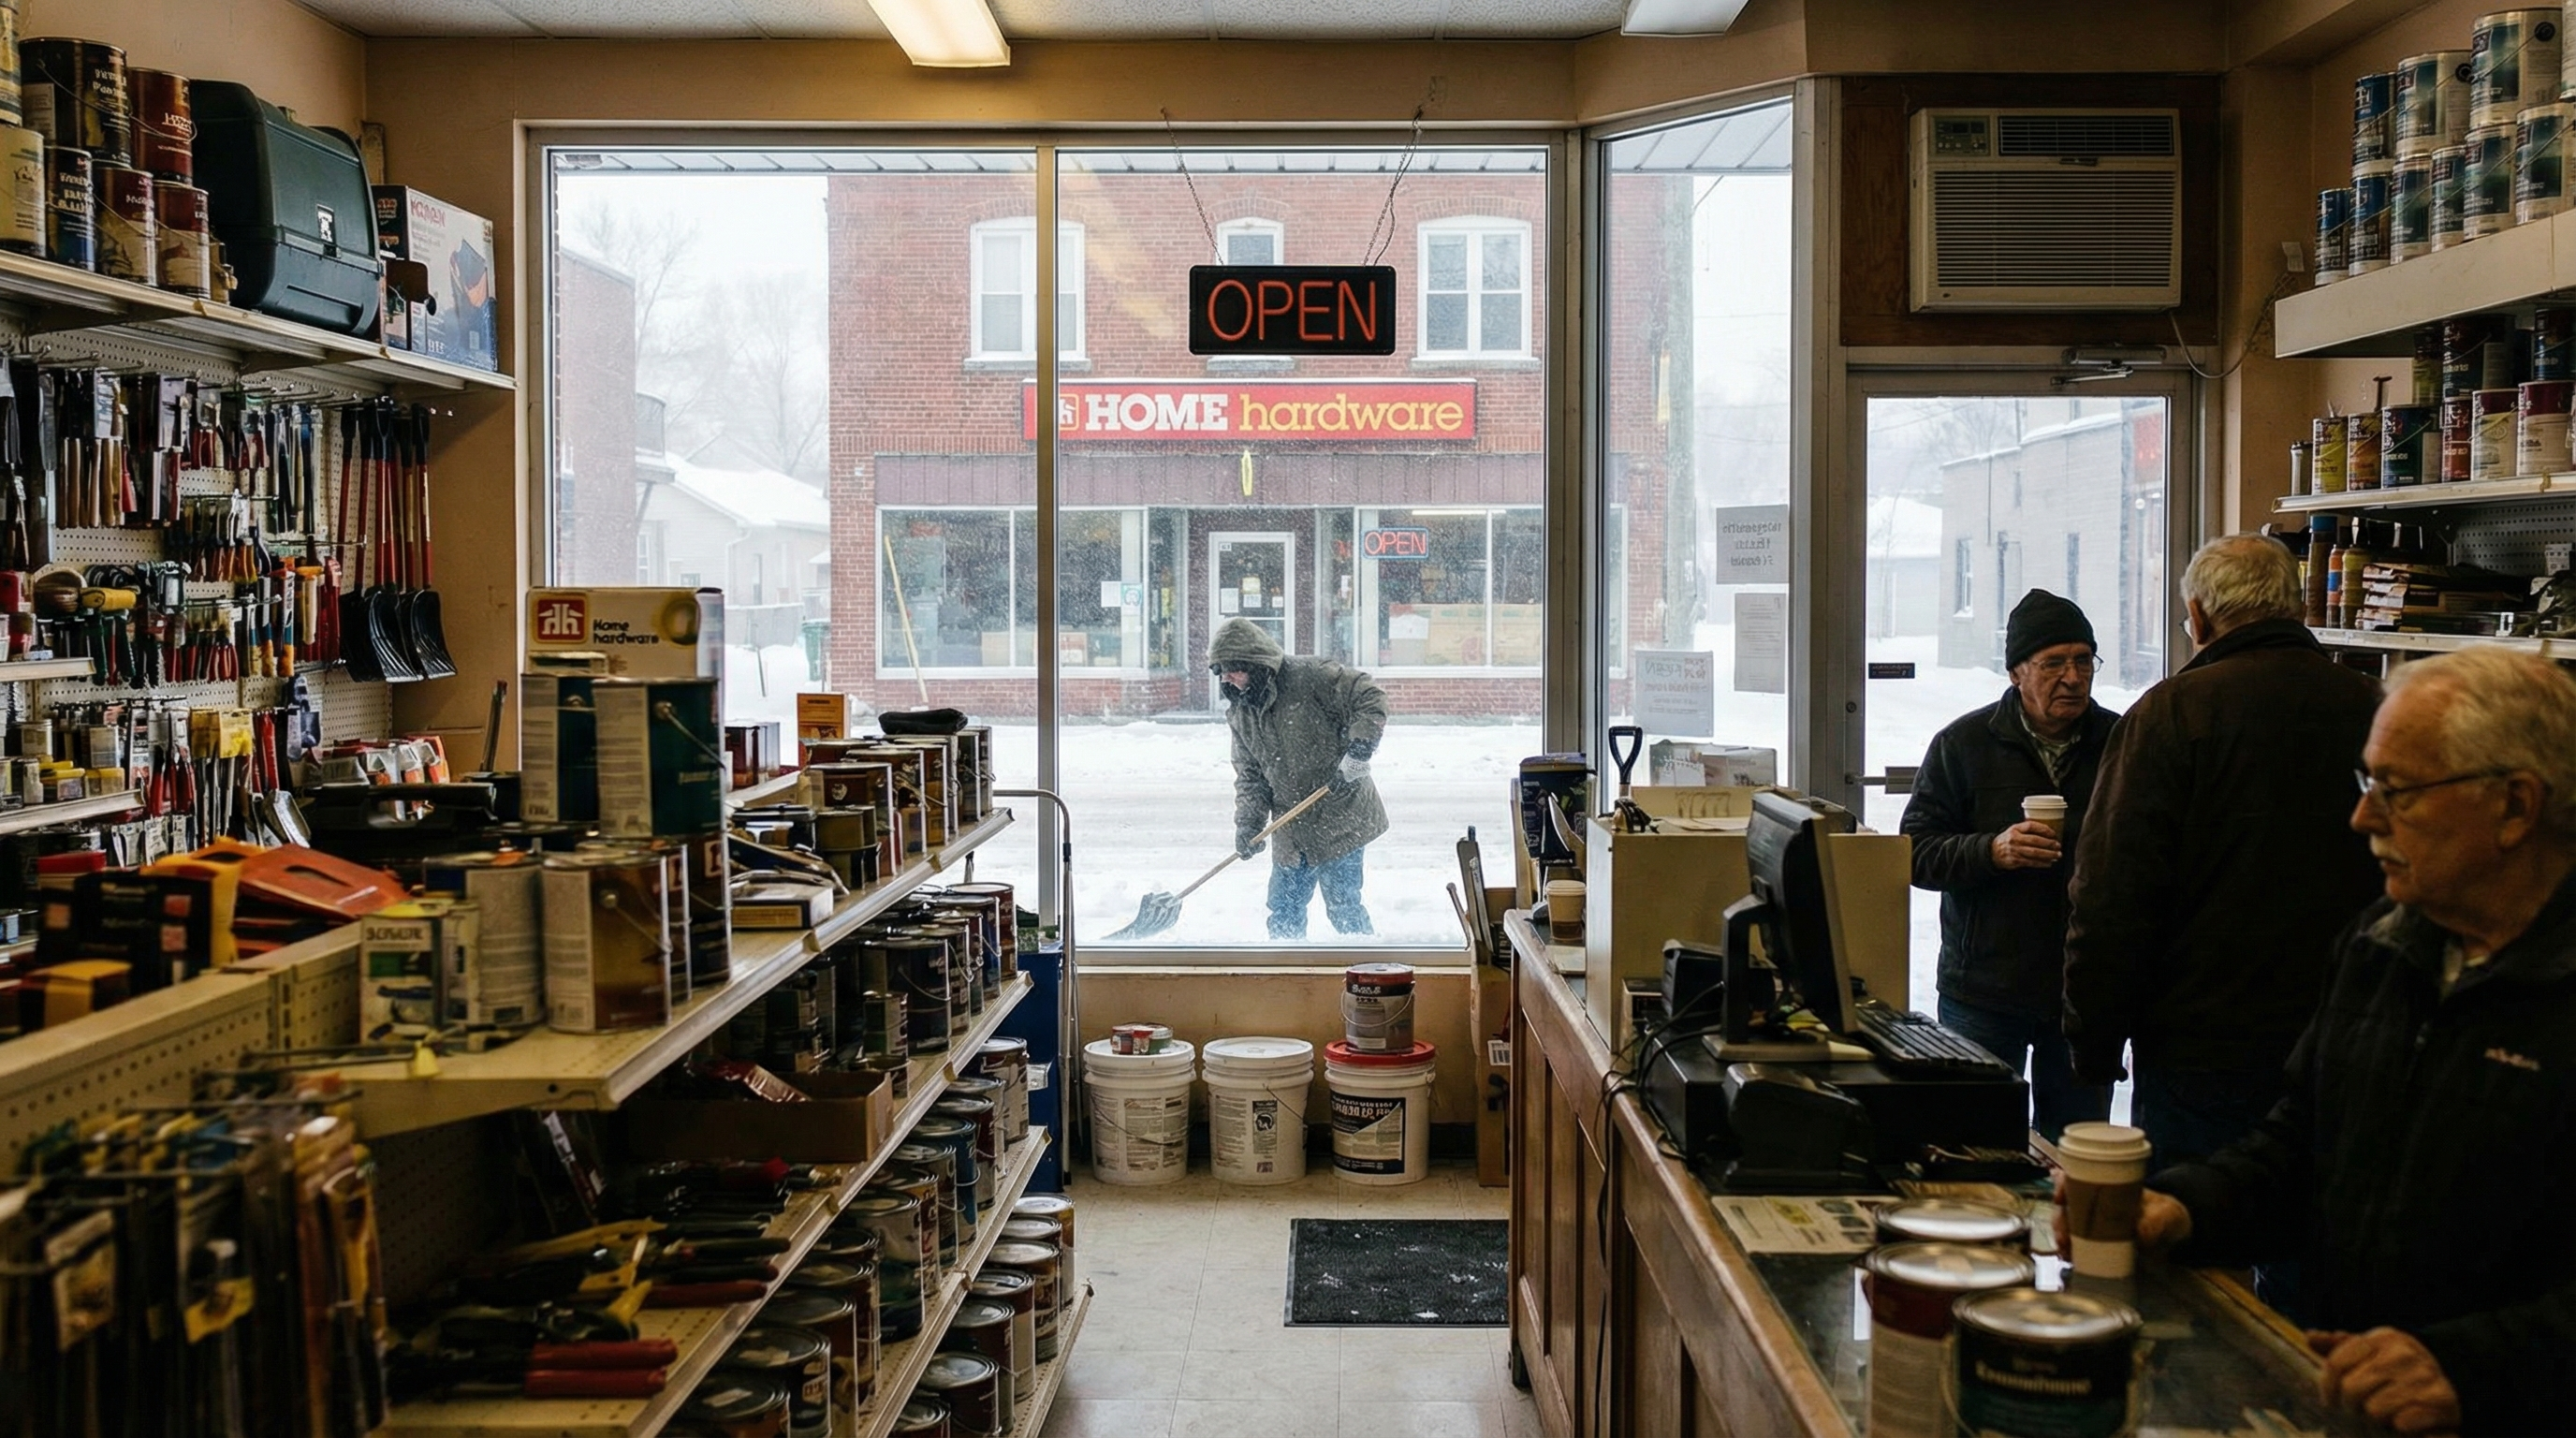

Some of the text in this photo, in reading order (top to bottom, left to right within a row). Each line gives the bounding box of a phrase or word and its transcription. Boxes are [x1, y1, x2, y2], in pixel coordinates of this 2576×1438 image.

[1208, 279, 1377, 342] OPEN
[1085, 392, 1229, 432] HOME
[1239, 392, 1464, 432] hardware
[1365, 531, 1427, 555] OPEN
[593, 619, 630, 632] Home
